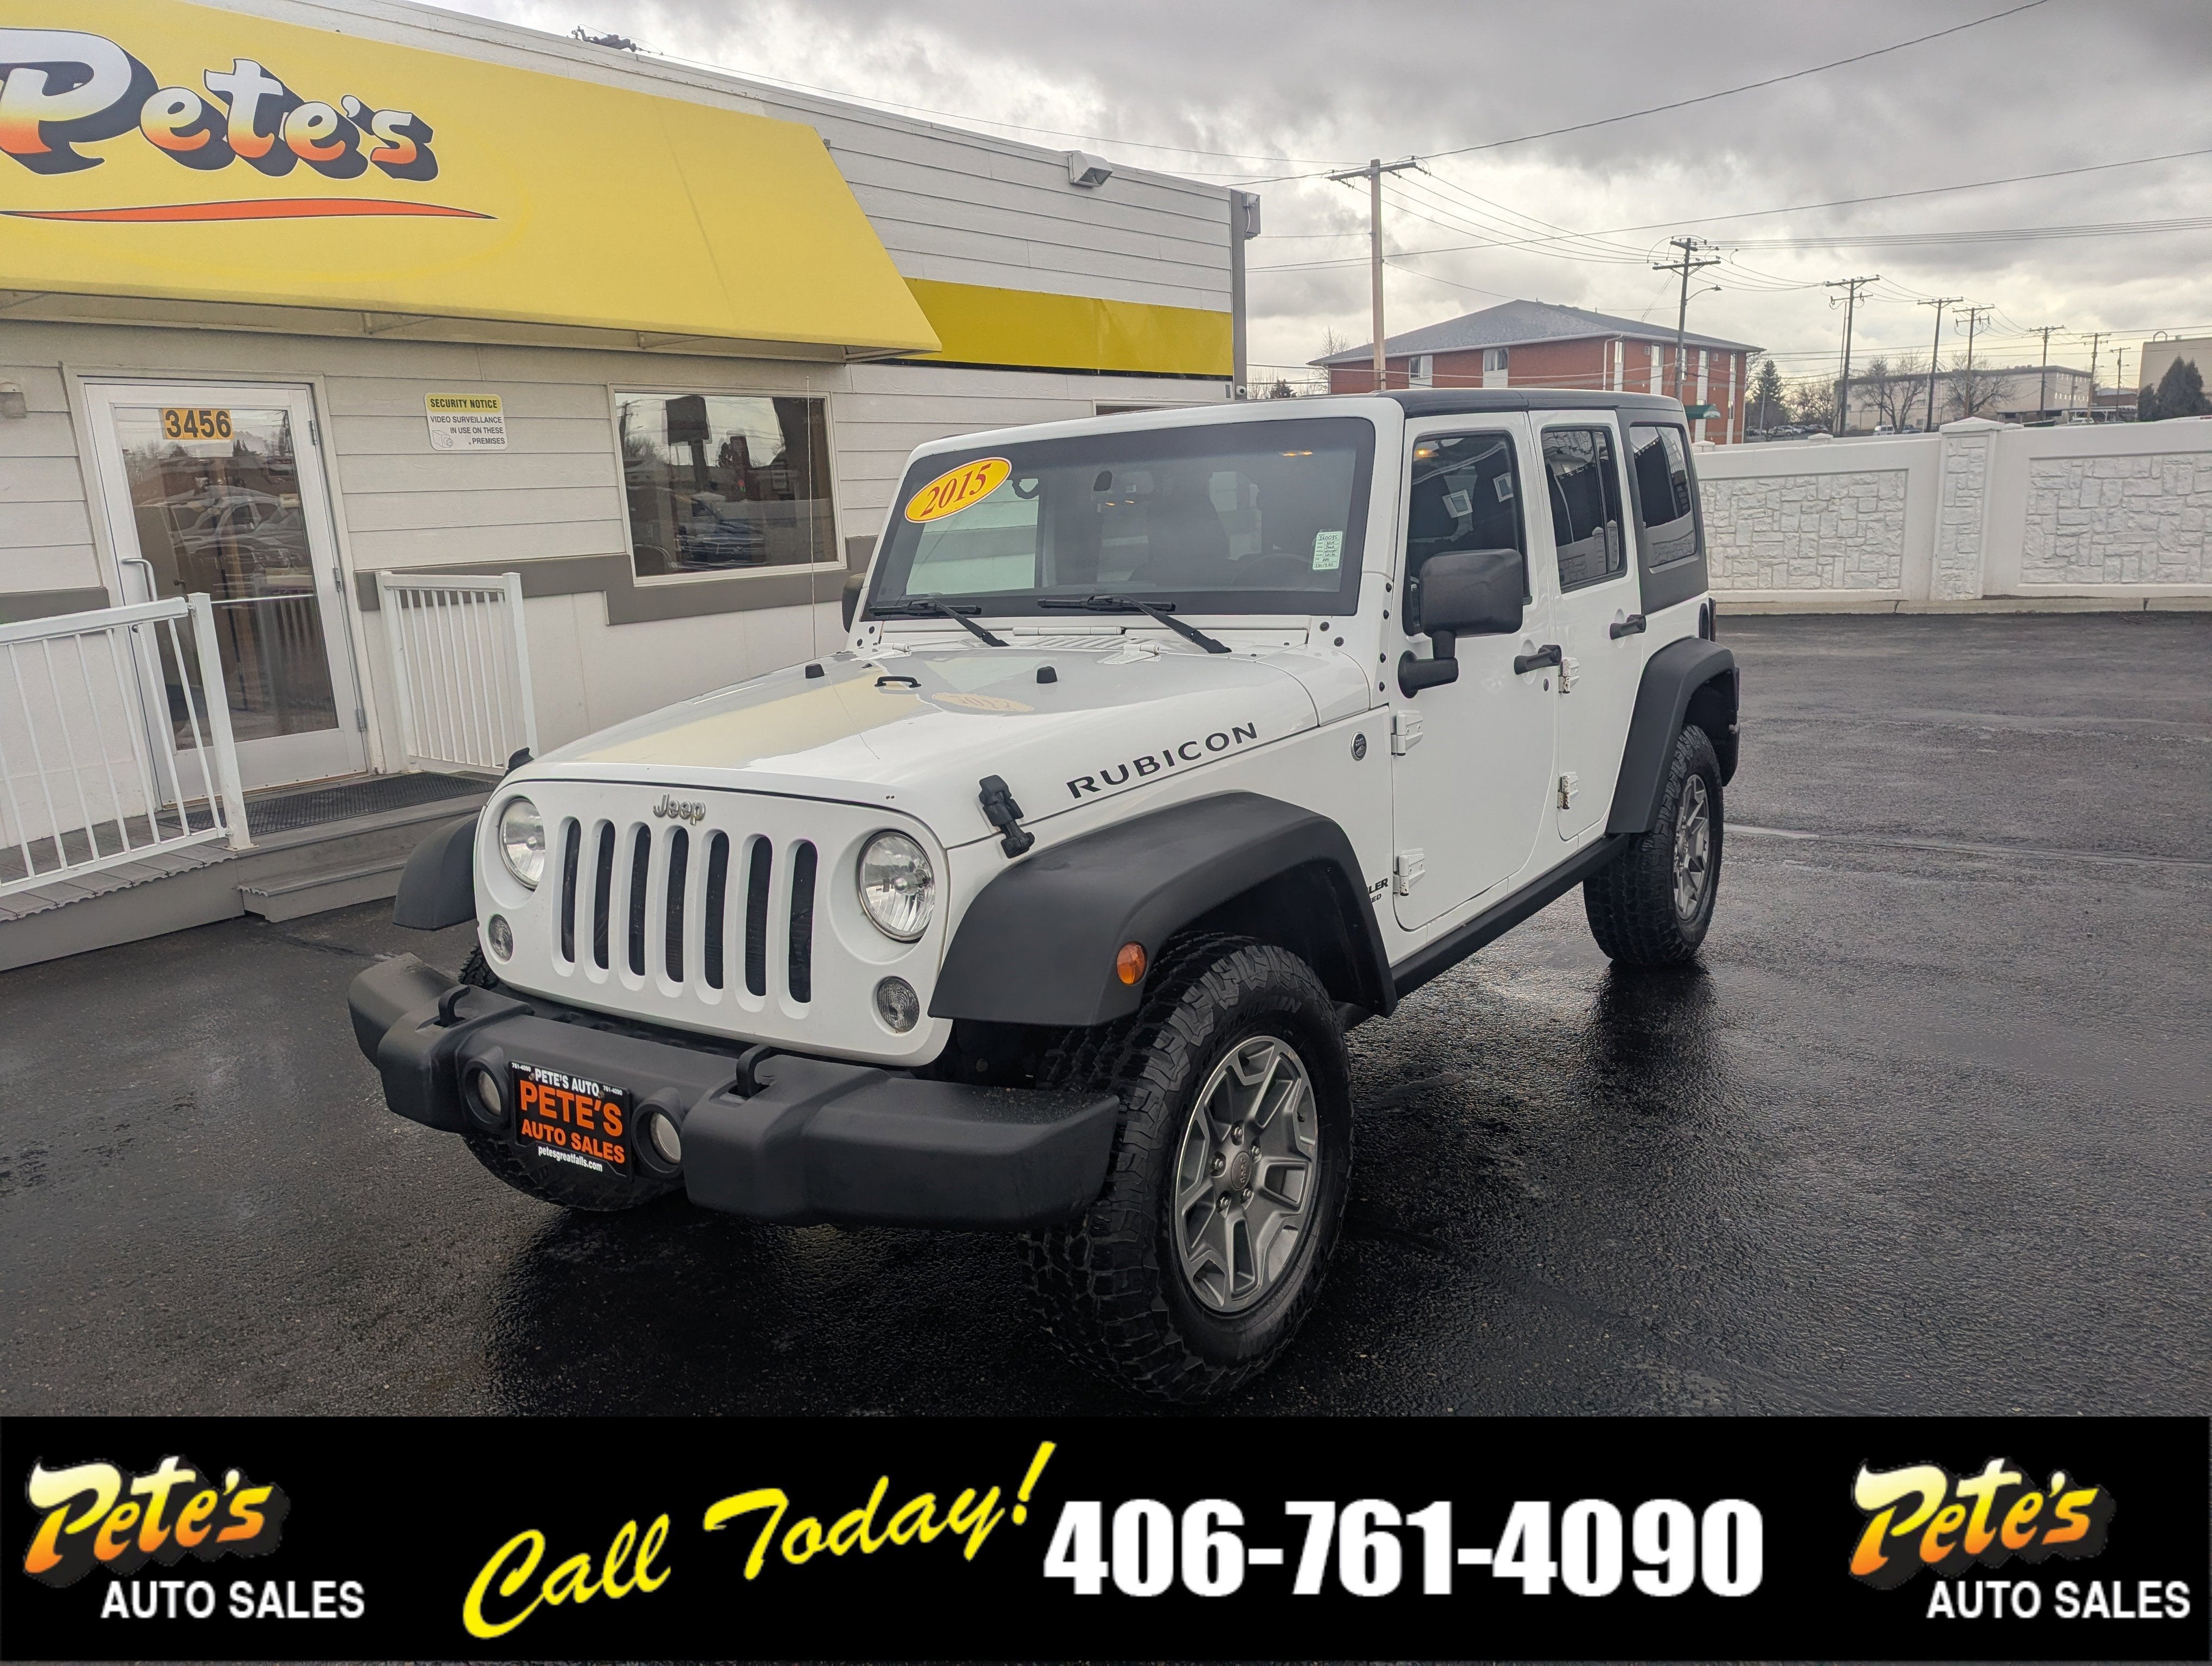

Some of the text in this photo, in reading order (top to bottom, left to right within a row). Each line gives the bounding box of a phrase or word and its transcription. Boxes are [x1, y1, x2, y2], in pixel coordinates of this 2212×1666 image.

[0, 28, 438, 181] Pete's
[430, 398, 498, 408] SECURITY NOTICE
[164, 409, 232, 438] 3456
[452, 415, 503, 424] SURVEILLANCE
[919, 462, 993, 518] 2015
[1066, 722, 1258, 799] RUBICON
[653, 793, 706, 825] Jeep
[534, 1067, 600, 1097] PETE'S AUTO
[519, 1079, 623, 1137] PETE'S
[521, 1118, 625, 1164] AUTO SALES
[538, 1145, 603, 1172] petesgreatfalls.com
